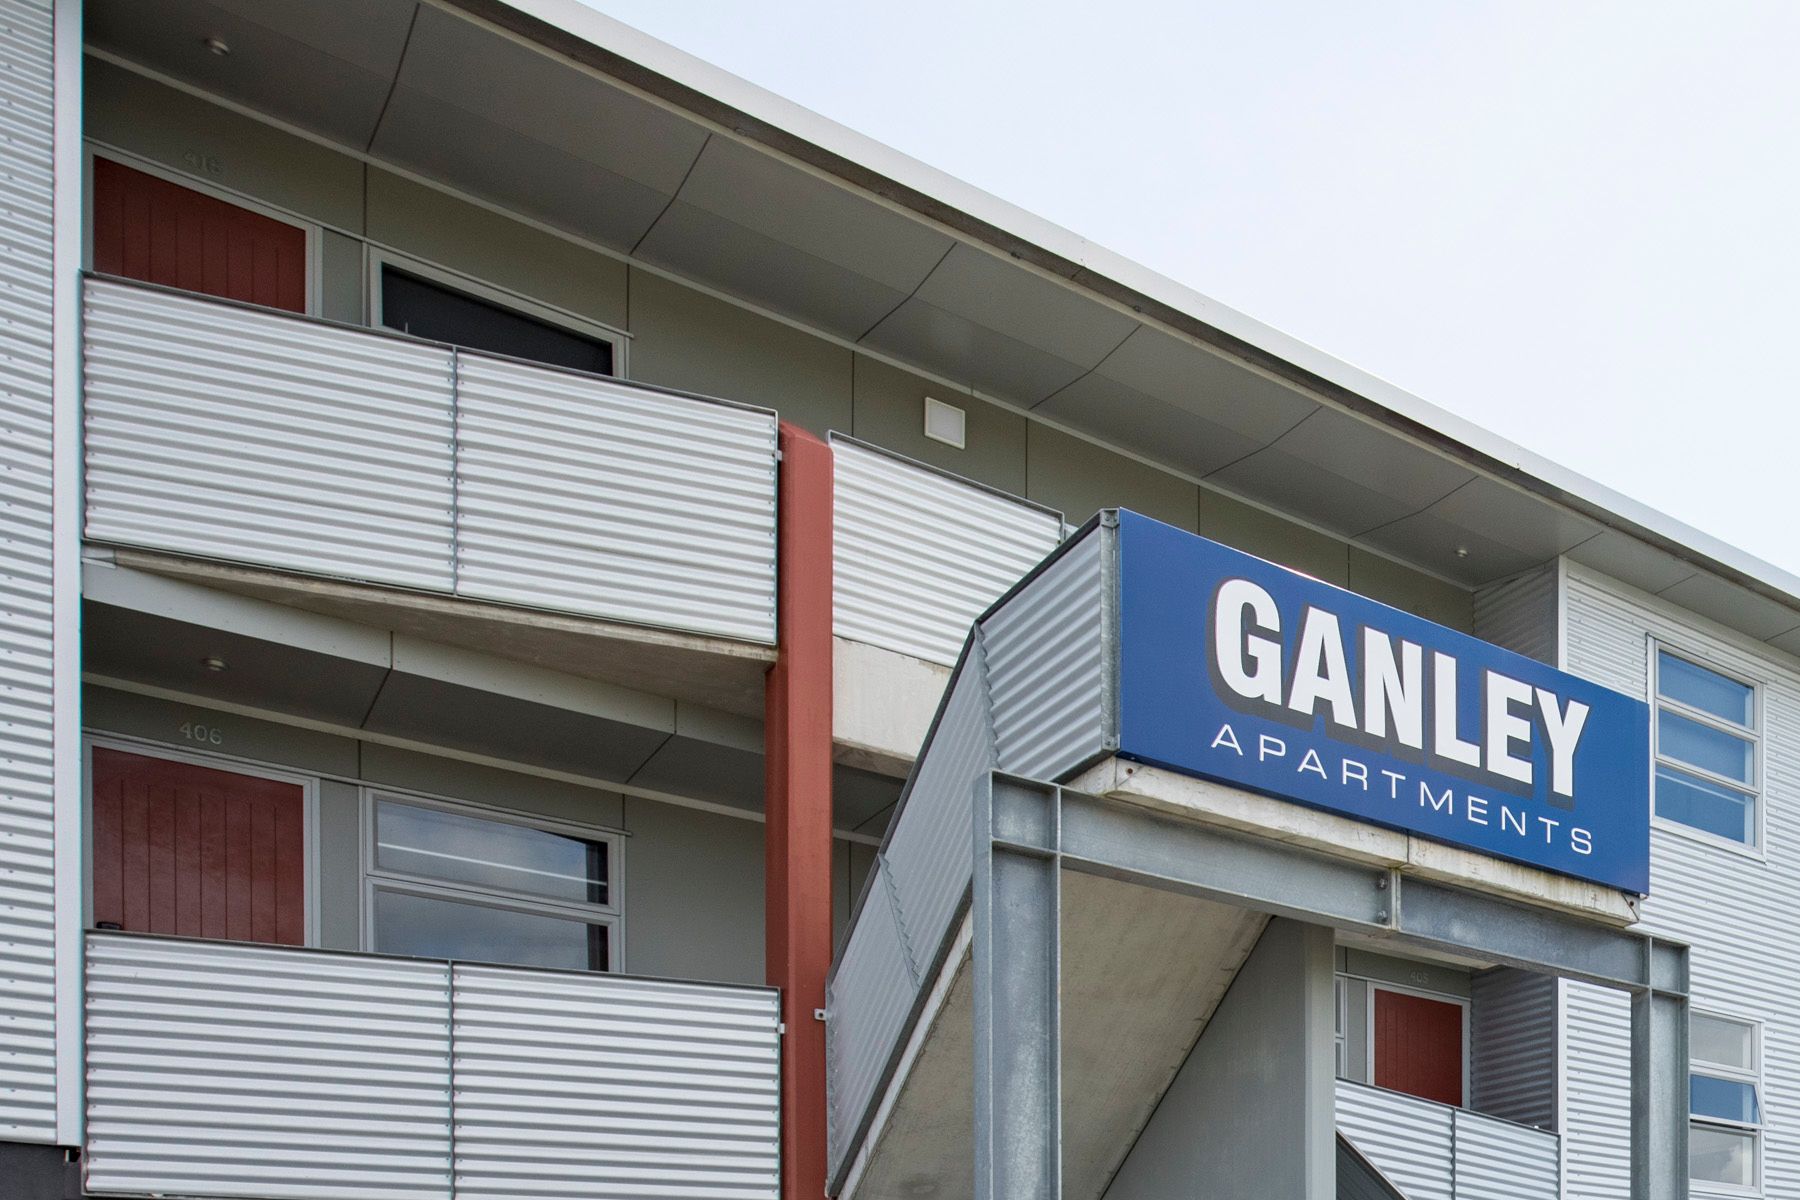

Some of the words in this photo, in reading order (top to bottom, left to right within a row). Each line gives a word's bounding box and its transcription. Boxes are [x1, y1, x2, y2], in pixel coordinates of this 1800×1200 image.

[180, 722, 222, 745] 406
[1214, 578, 1590, 798] GANLEY
[1211, 723, 1592, 856] APARTMENTS
